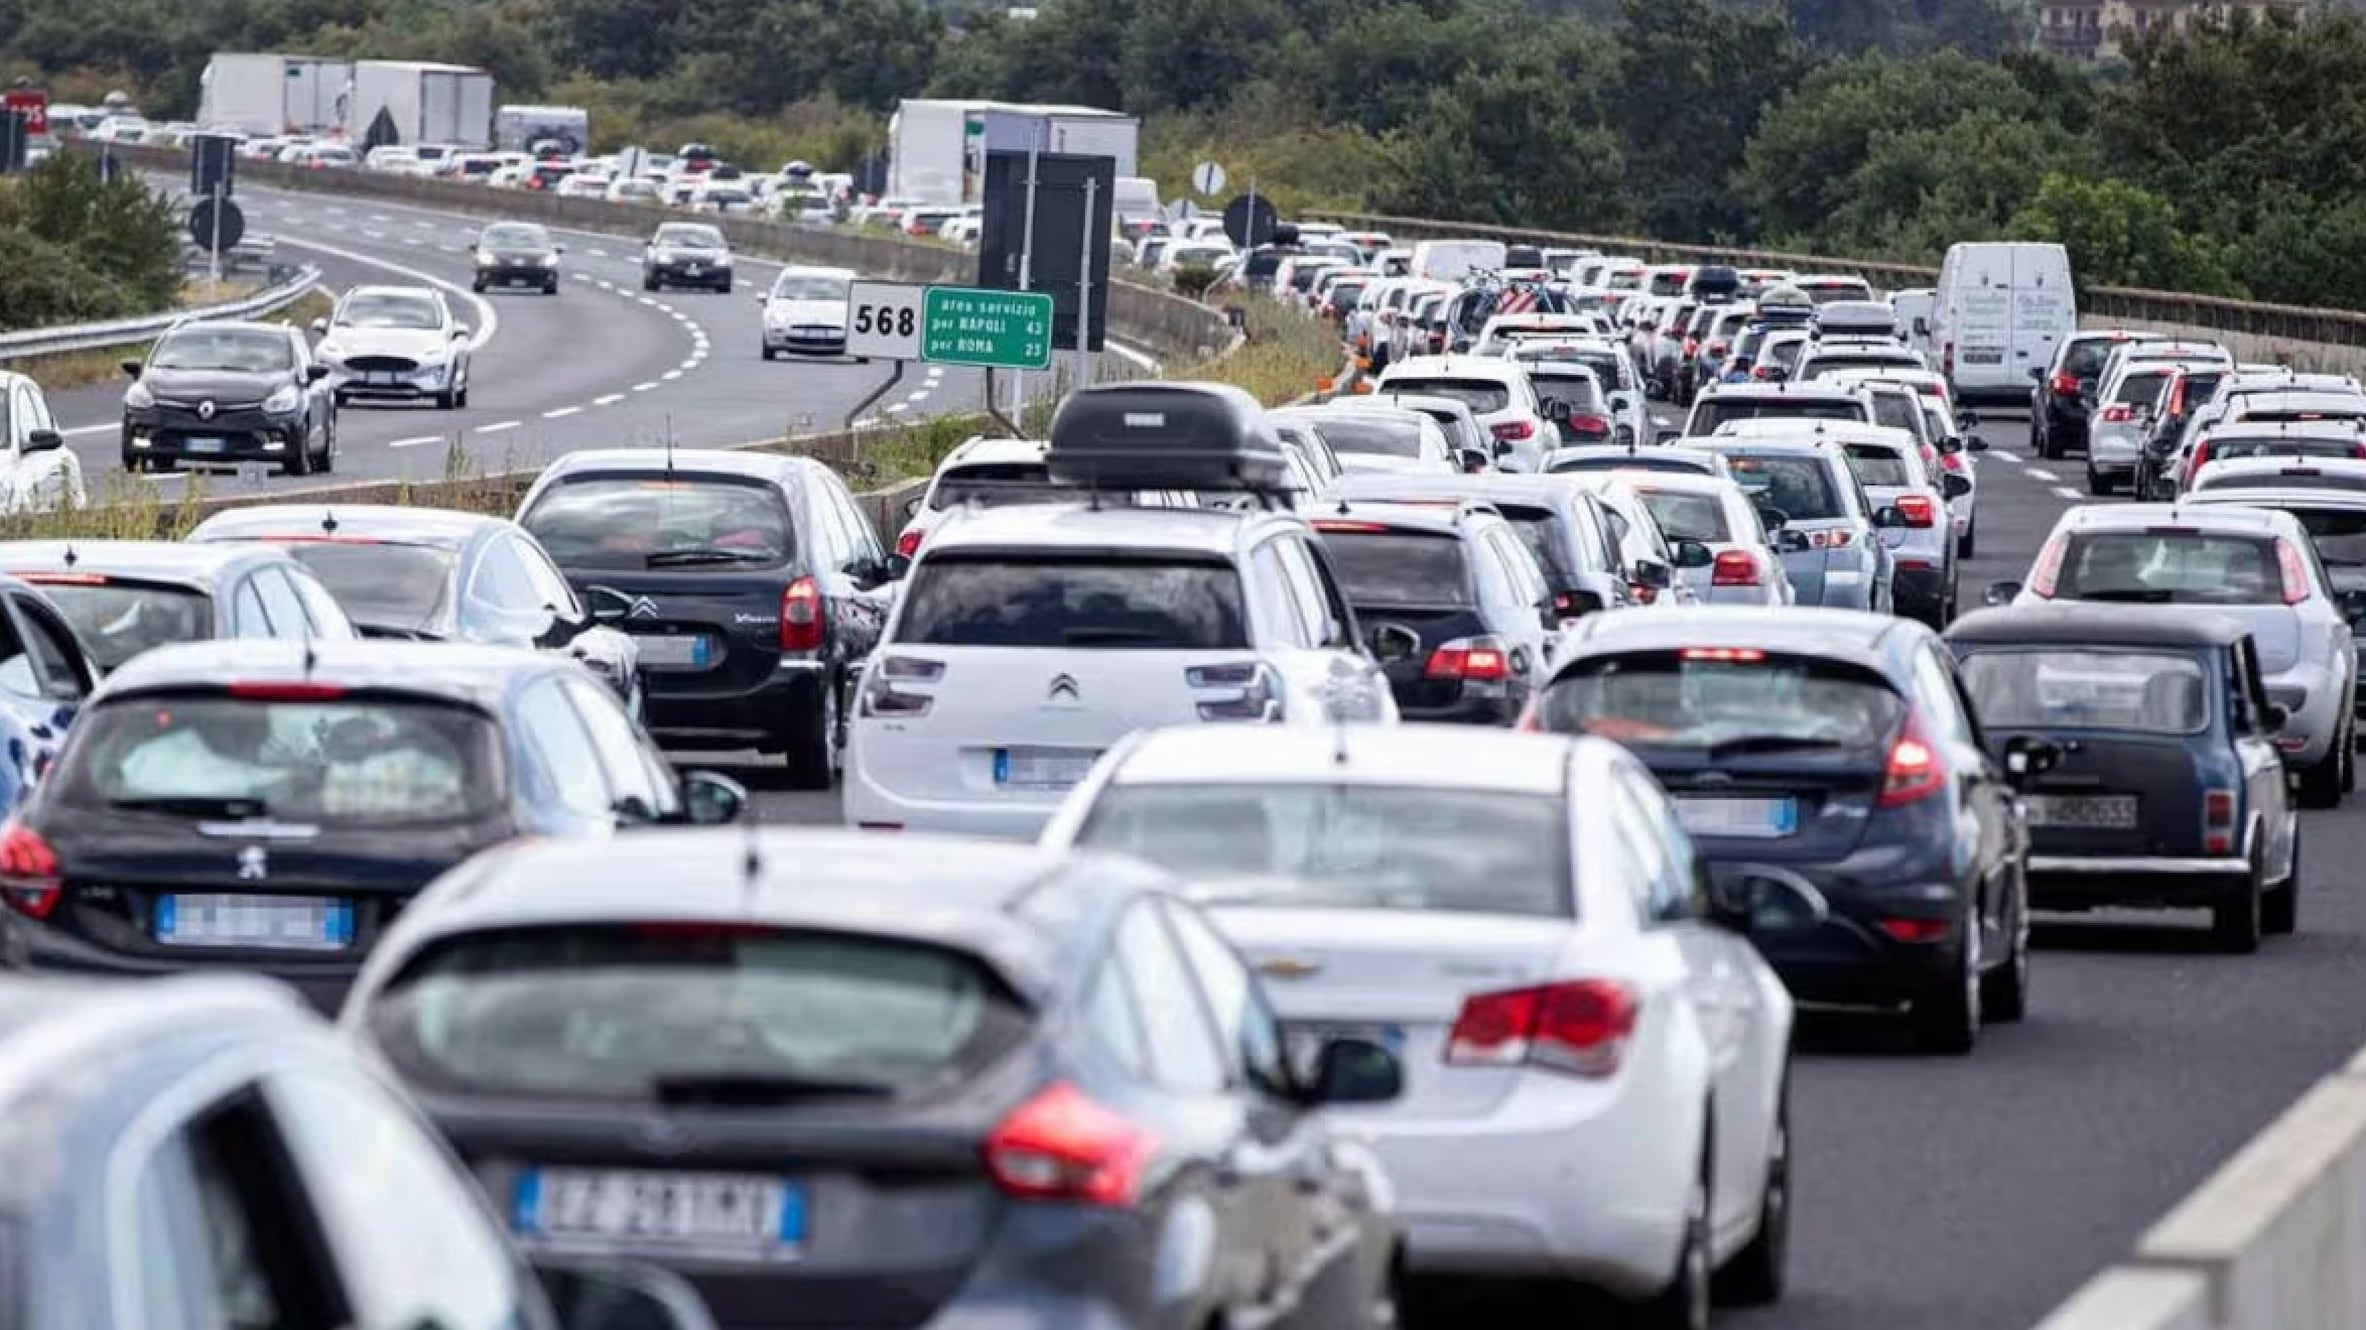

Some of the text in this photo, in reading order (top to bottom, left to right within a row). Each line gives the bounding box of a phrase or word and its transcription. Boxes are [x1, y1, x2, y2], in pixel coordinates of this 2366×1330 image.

[942, 300, 1035, 317] area servizio
[855, 304, 915, 337] 568
[932, 318, 1042, 336] per NAPOLI 43
[932, 339, 1041, 357] per ROMA 23
